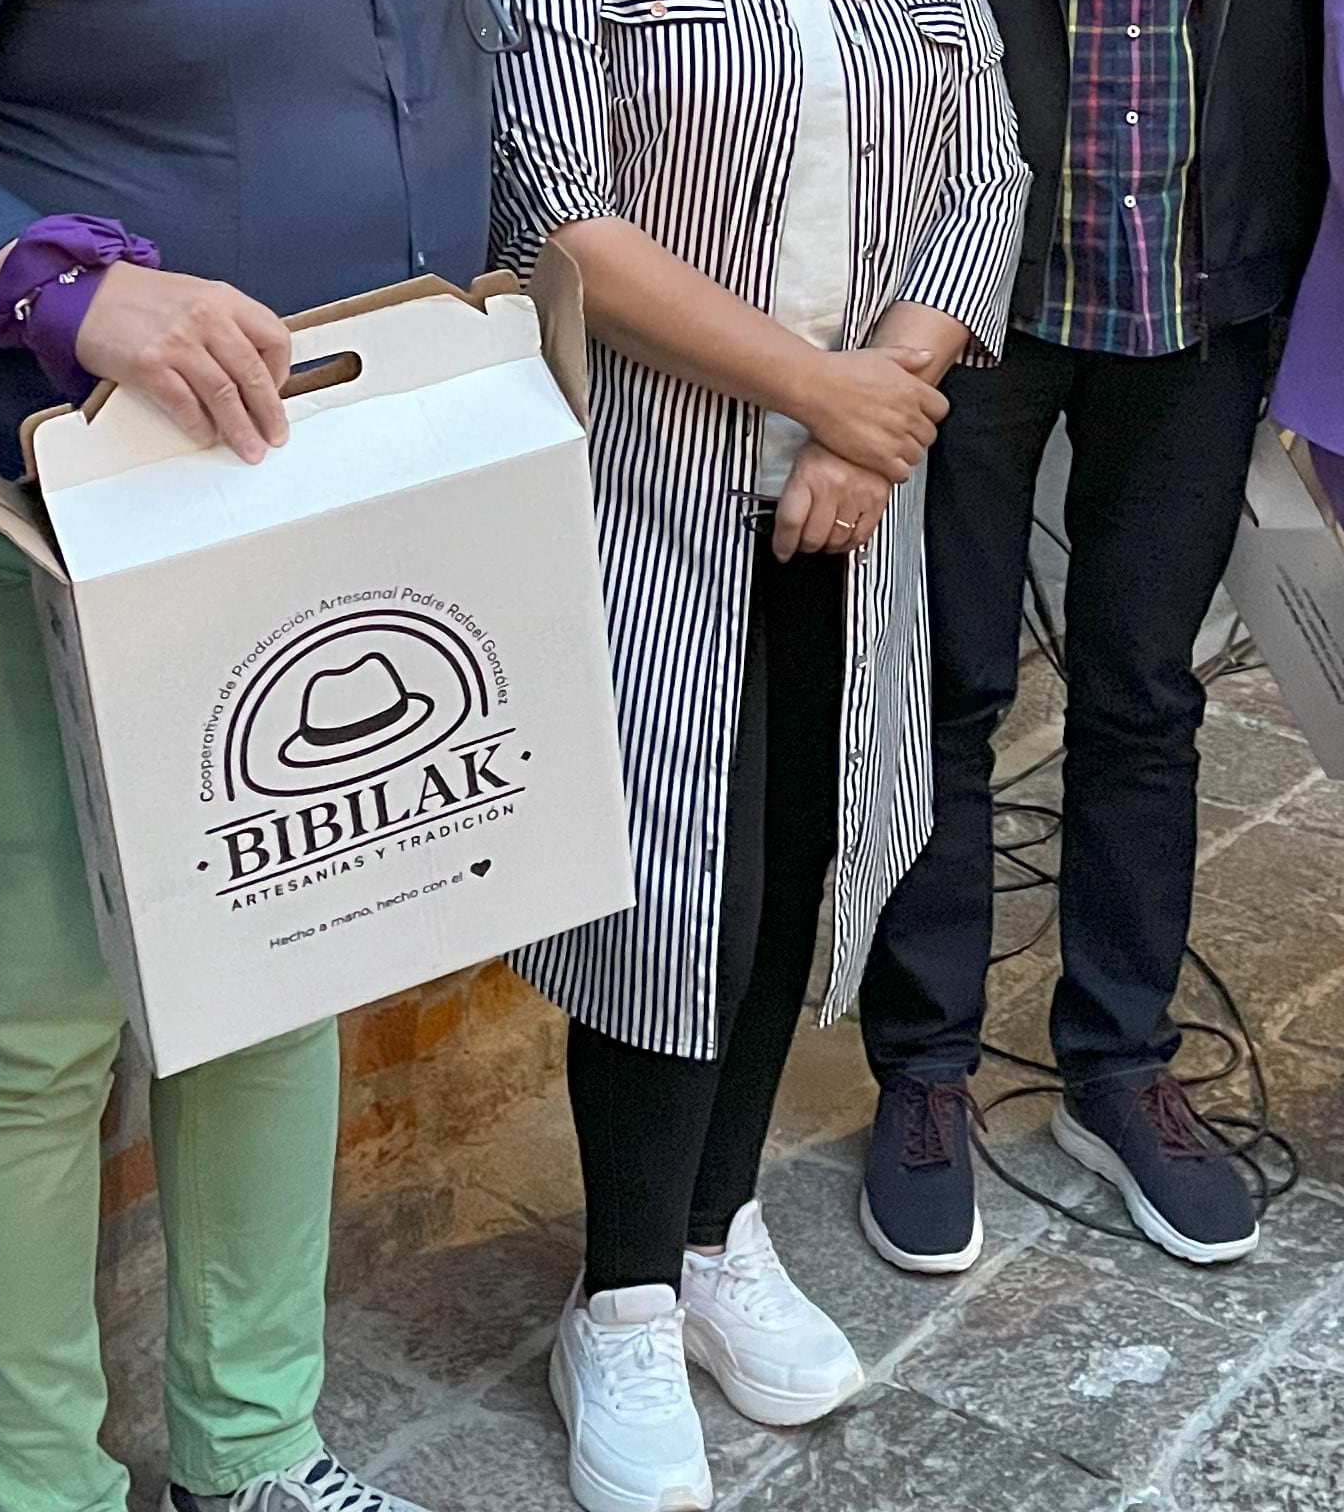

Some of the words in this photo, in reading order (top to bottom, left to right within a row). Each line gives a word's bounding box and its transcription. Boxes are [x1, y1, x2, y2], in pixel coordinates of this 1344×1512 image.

[199, 703, 225, 803] Cooperativa
[218, 680, 237, 701] de
[231, 608, 316, 678] Producción
[319, 586, 399, 614] Artesanal
[401, 587, 445, 611] Padre
[446, 603, 488, 642] Rafael
[482, 639, 510, 706] González
[221, 742, 511, 882] BIBILAK
[231, 855, 365, 913] ARTESANÍAS
[375, 847, 387, 861] Y
[397, 803, 515, 852] TRADICIÓN
[269, 927, 316, 950] Hecho
[319, 922, 328, 933] a
[331, 906, 374, 928] mano,
[376, 889, 419, 912] hecho
[422, 878, 447, 895] con
[451, 871, 464, 885] el
